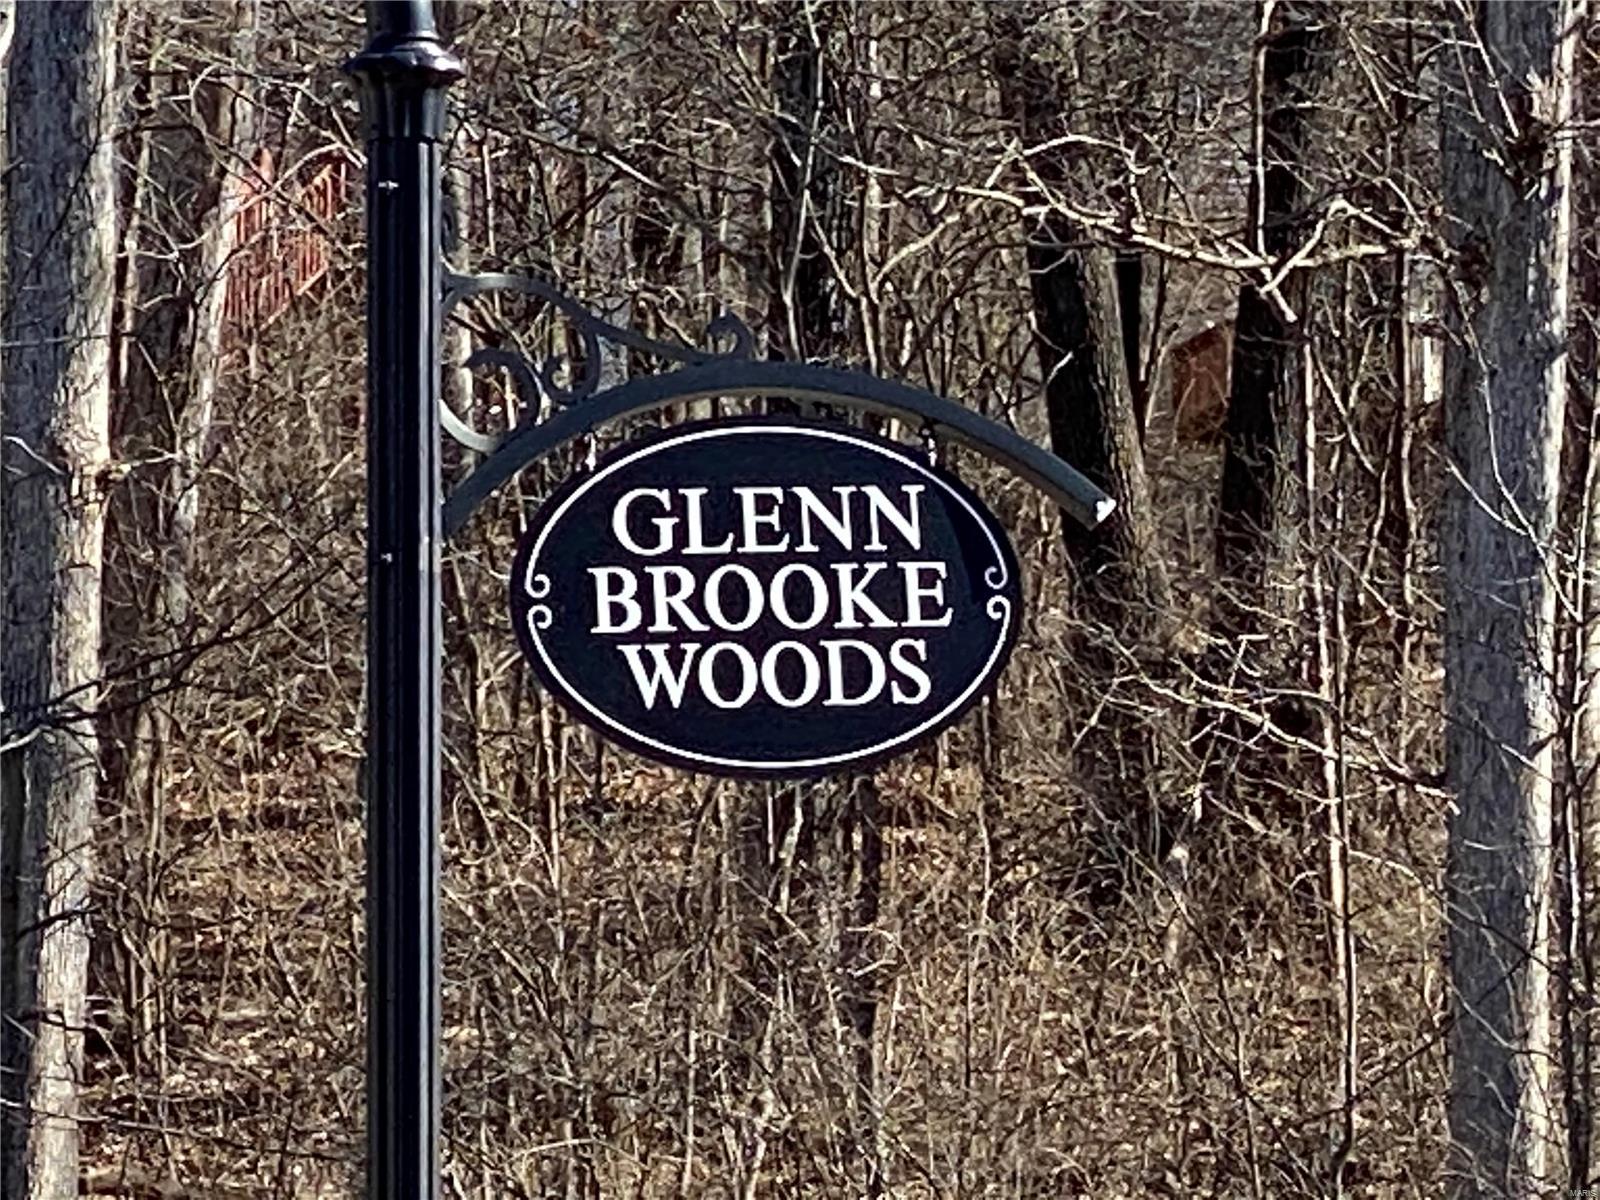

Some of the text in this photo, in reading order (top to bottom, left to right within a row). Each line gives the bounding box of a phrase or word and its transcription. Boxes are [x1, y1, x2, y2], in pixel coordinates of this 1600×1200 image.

[612, 484, 926, 556] GLENN
[587, 561, 954, 634] BROOKE
[616, 638, 932, 710] WOODS
